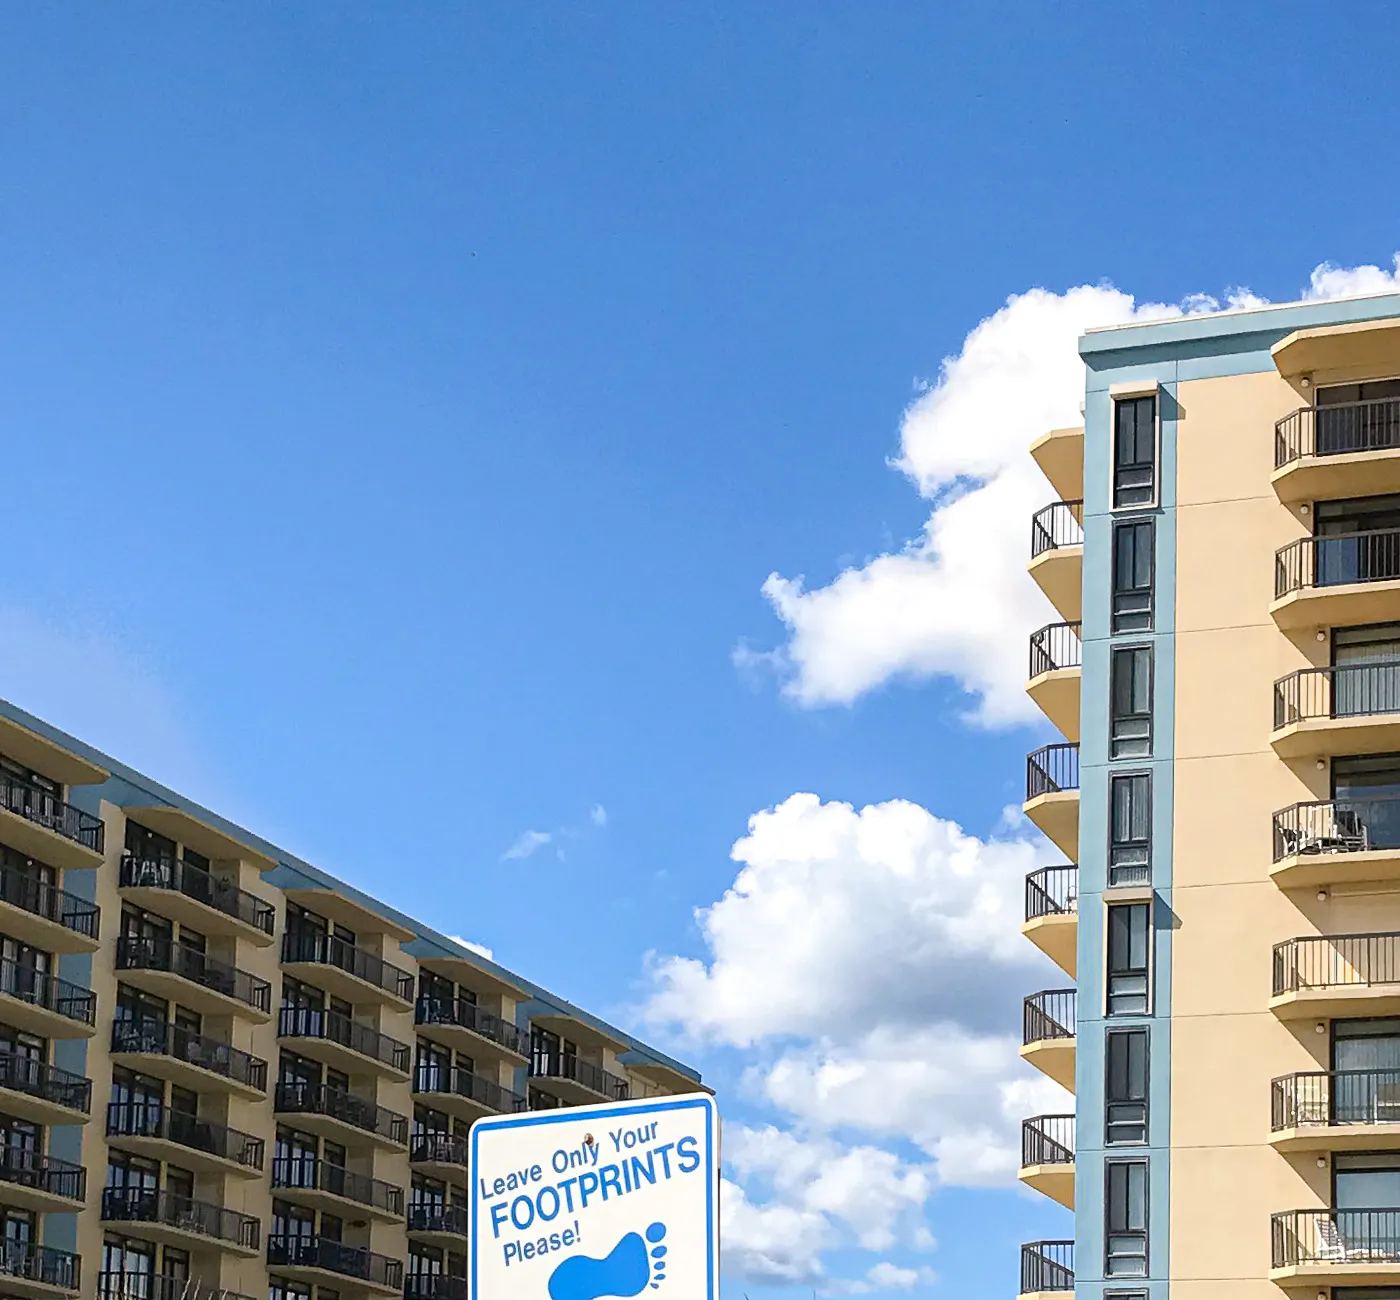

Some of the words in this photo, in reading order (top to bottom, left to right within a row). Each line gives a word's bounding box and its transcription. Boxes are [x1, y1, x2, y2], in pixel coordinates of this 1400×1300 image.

[480, 1164, 543, 1200] Leave
[552, 1142, 599, 1174] Only
[609, 1121, 658, 1152] Your
[490, 1136, 701, 1239] FOOTPRINTS
[503, 1220, 581, 1267] Please!
